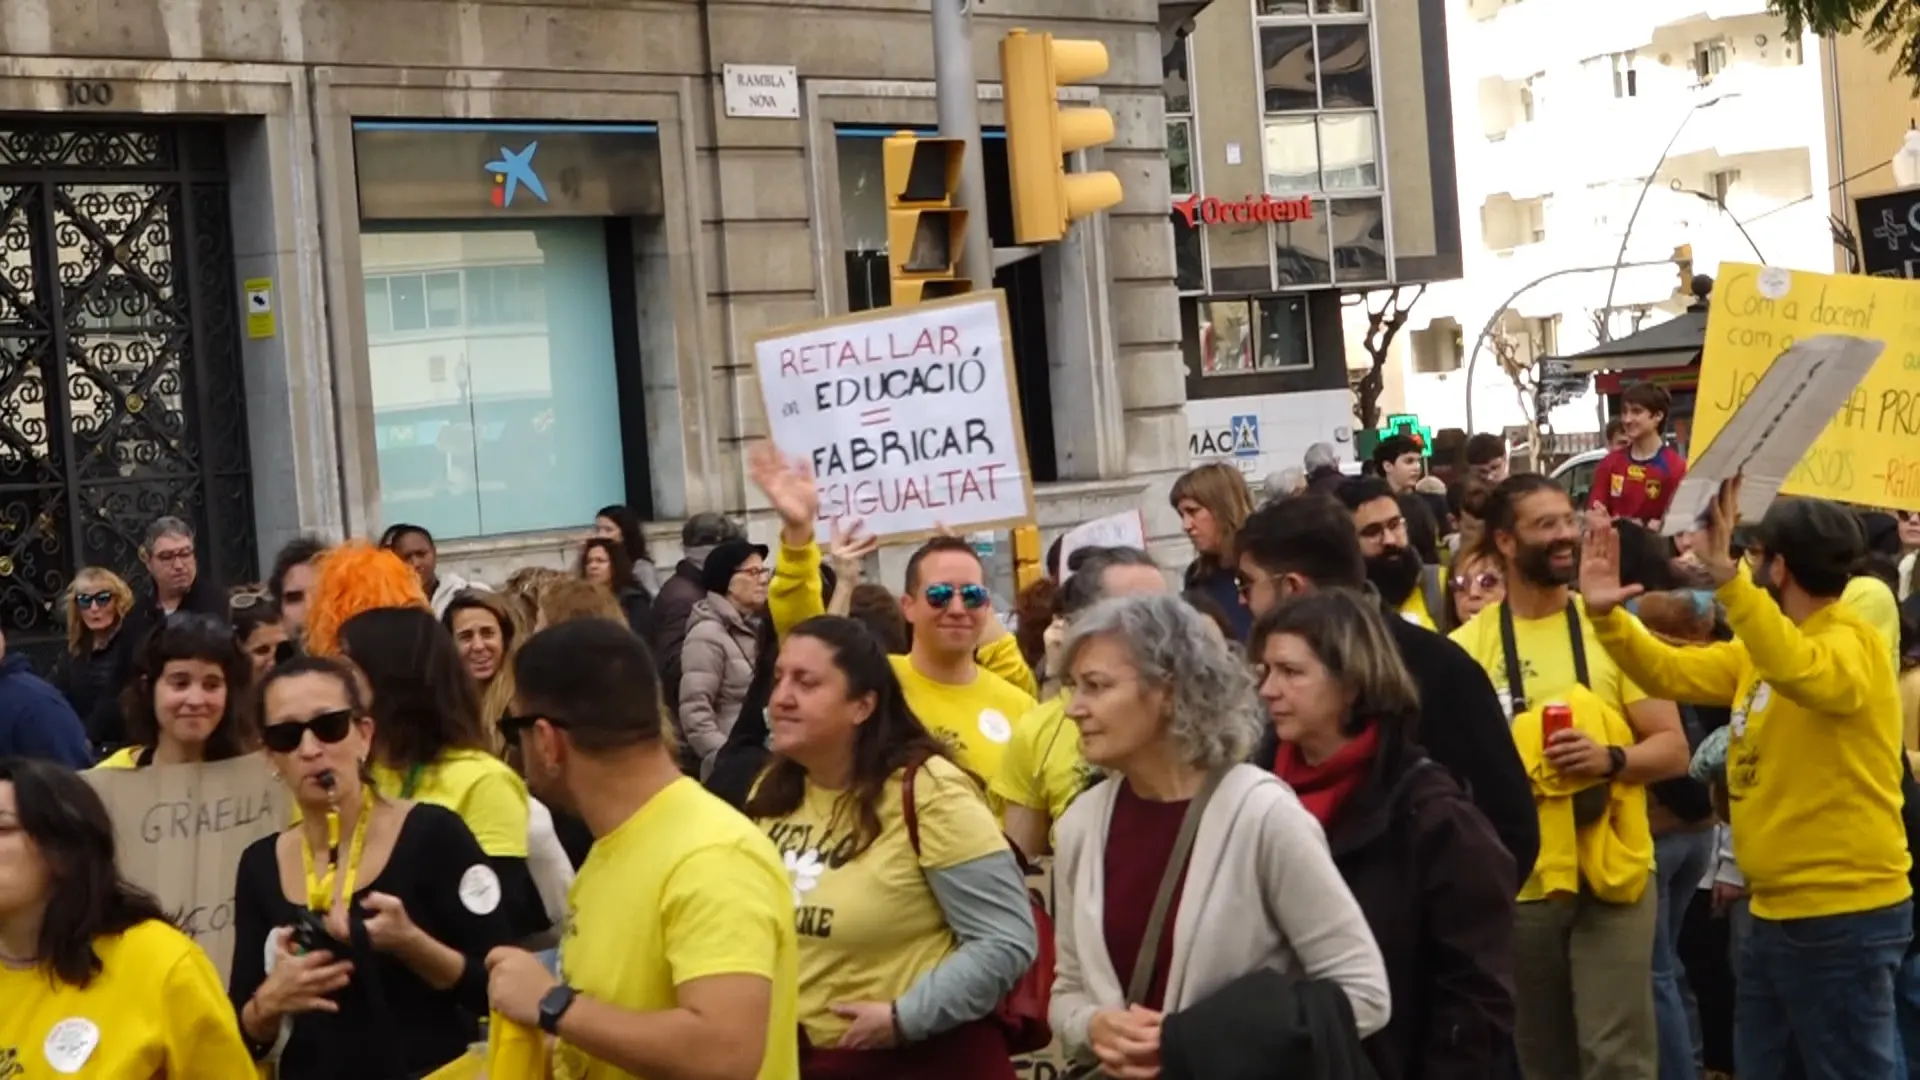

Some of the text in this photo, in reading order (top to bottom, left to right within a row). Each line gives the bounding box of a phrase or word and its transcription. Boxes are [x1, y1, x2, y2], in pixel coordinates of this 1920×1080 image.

[65, 80, 114, 106] 100
[737, 73, 785, 88] RAMBLA
[748, 94, 777, 108] NOVA
[1201, 194, 1312, 224] Occident
[1783, 300, 1799, 322] a
[1810, 283, 1876, 330] docent
[780, 325, 961, 378] RETALLAR
[1727, 326, 1772, 348] com
[815, 346, 986, 411] EDUCACIÓ
[812, 418, 995, 478] FABRICAR
[815, 463, 1006, 520] ESIGUALTAT
[141, 788, 273, 843] GRAELLA
